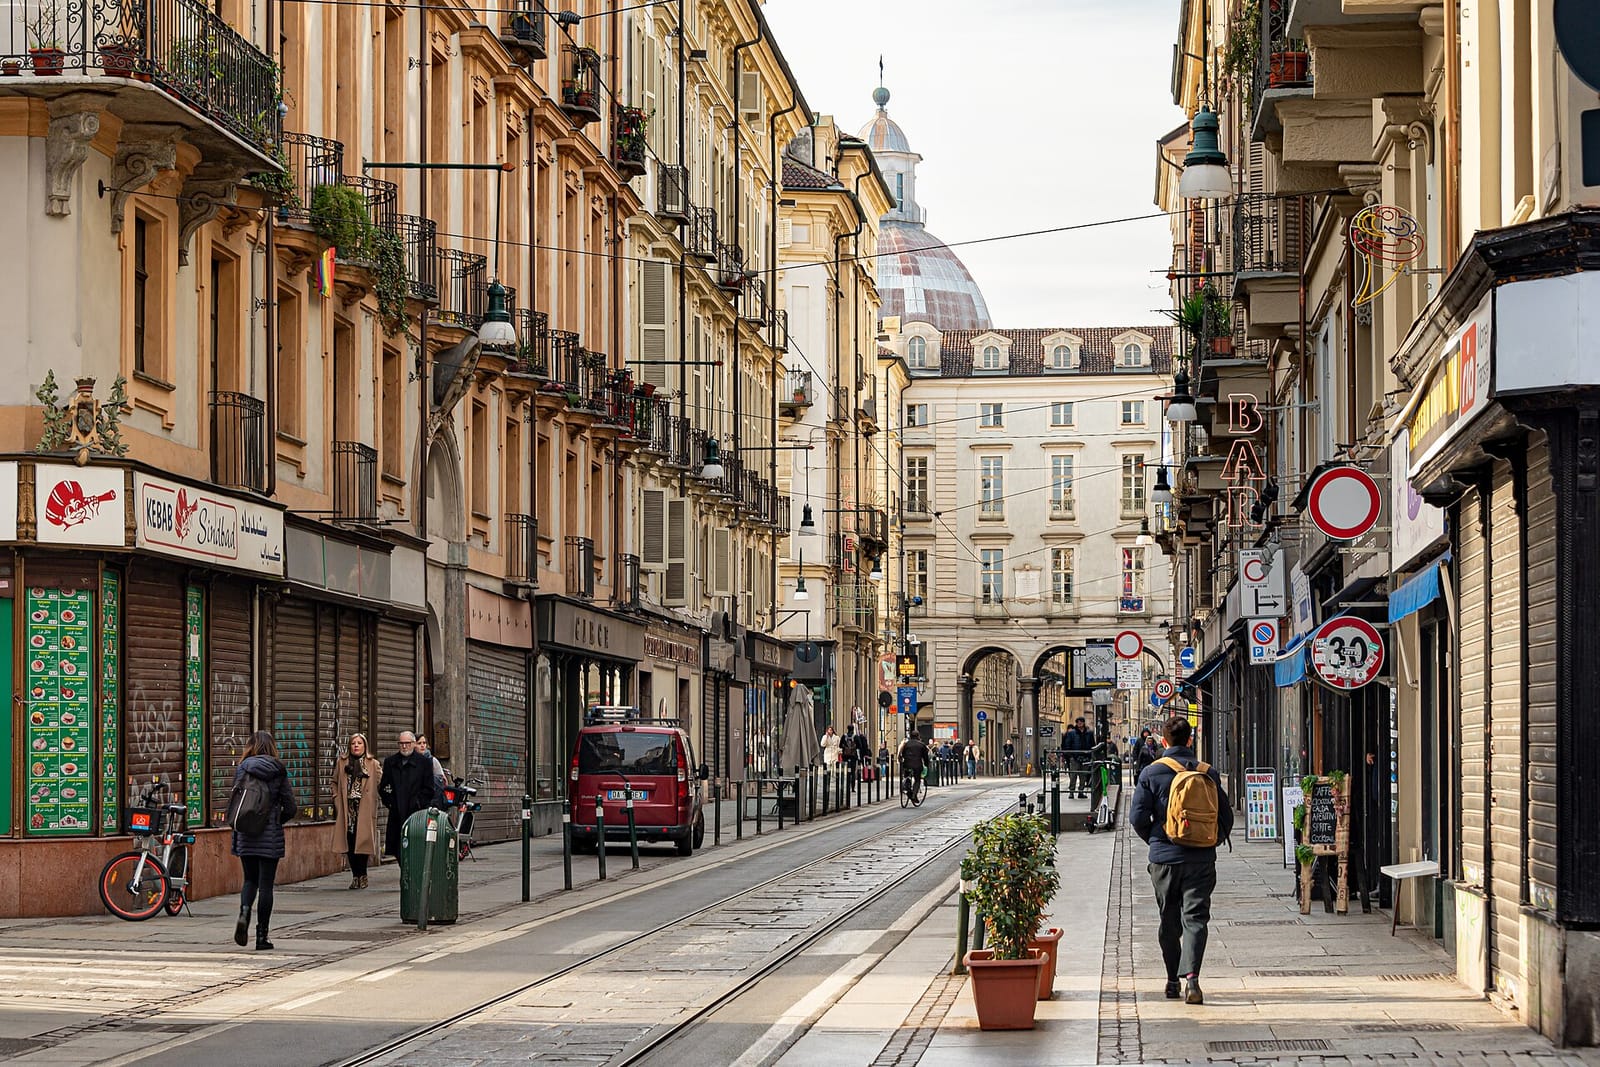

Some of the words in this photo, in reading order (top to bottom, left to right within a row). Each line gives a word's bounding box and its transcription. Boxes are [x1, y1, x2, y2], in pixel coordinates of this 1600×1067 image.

[1220, 393, 1267, 528] BAR
[146, 497, 173, 533] KEBAB
[197, 507, 236, 550] Sindbad
[1329, 636, 1368, 669] 30
[1158, 685, 1170, 694] 30
